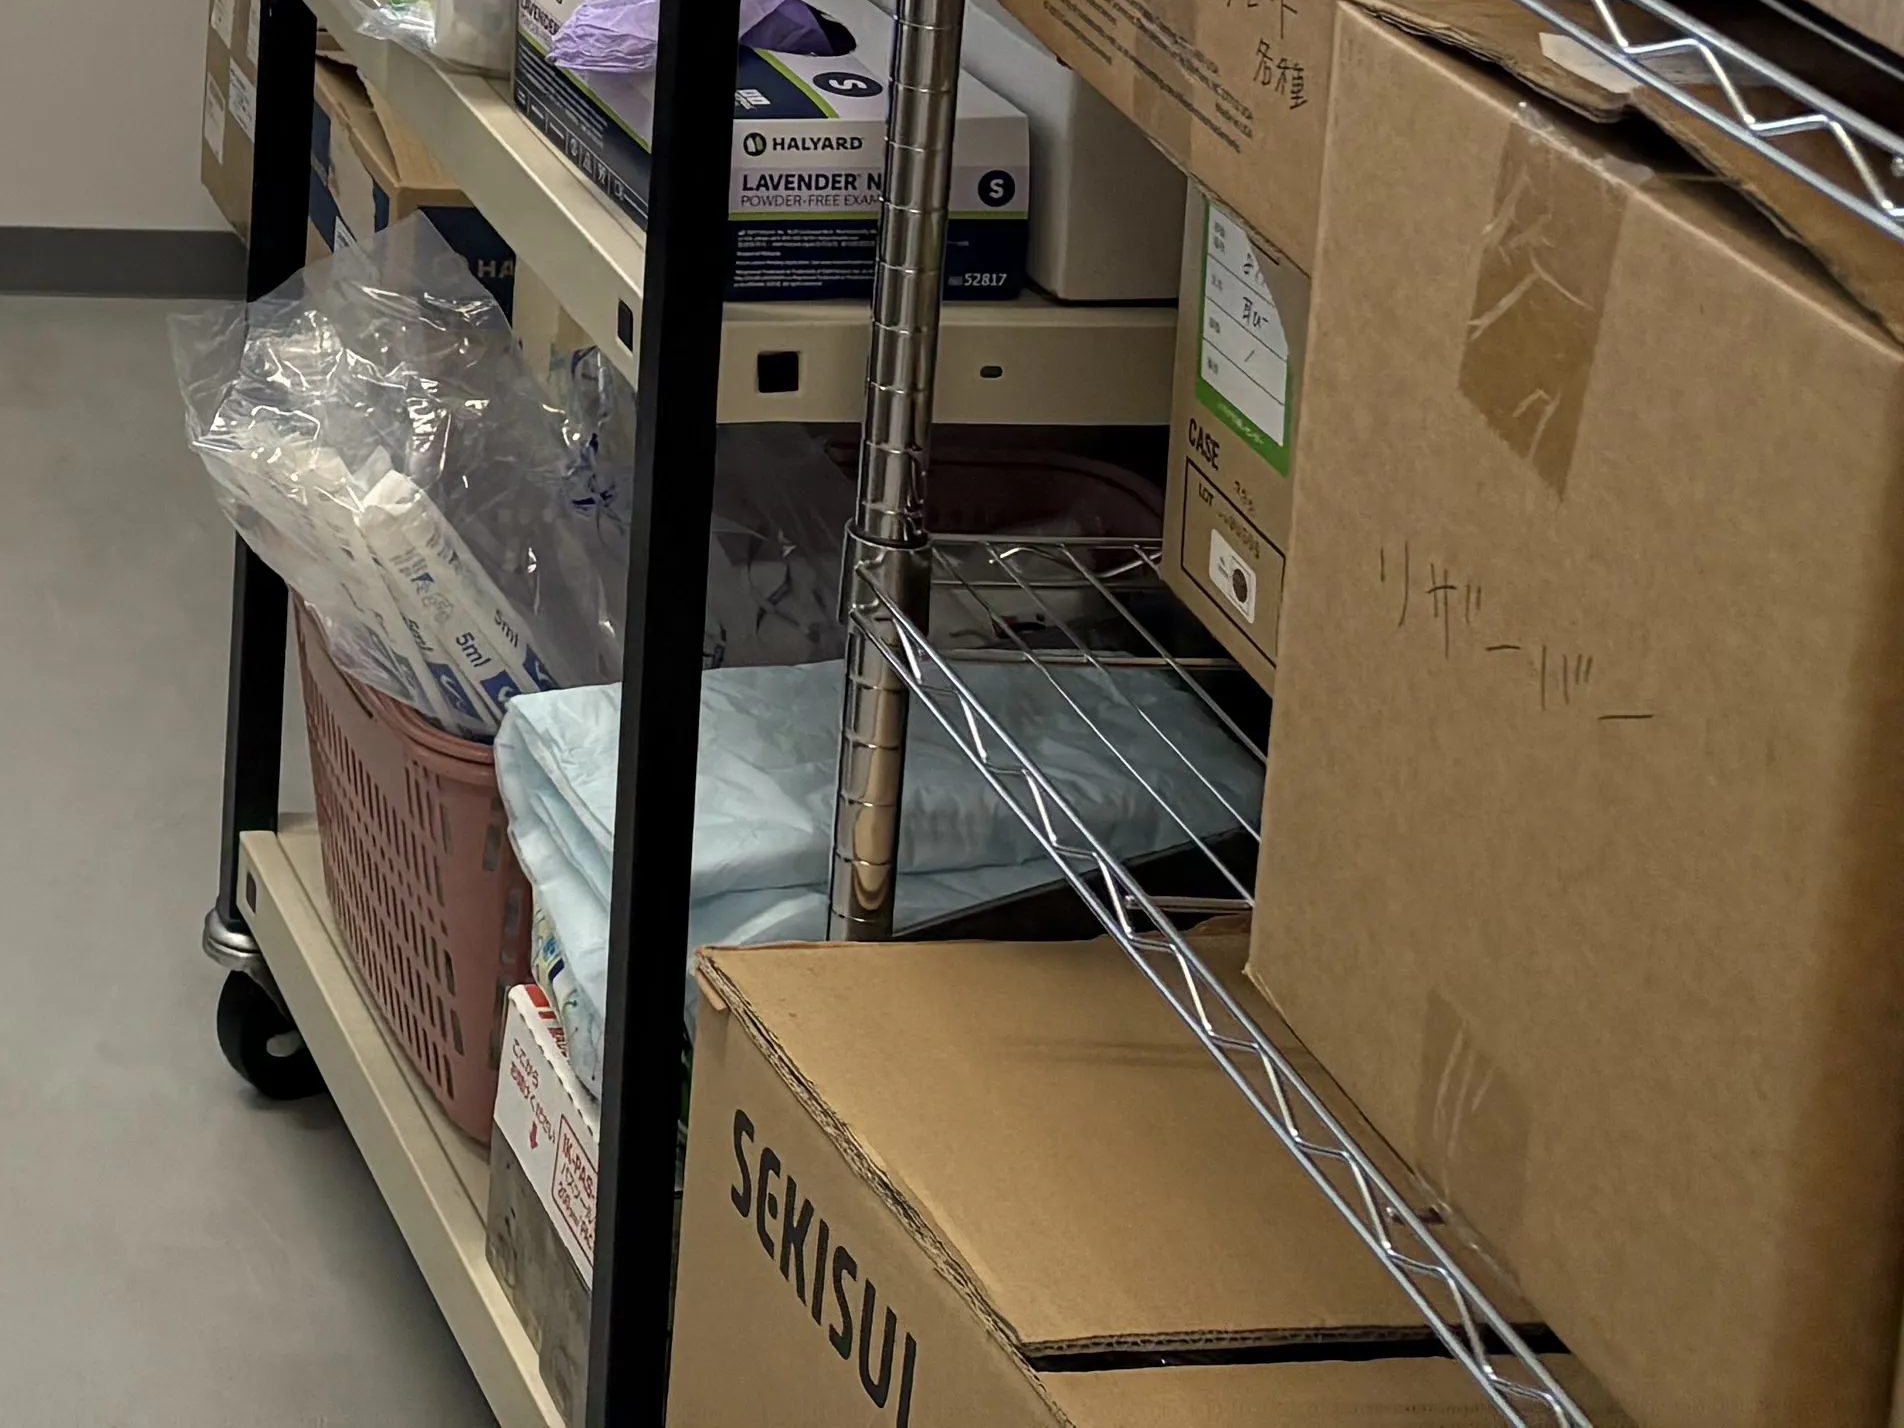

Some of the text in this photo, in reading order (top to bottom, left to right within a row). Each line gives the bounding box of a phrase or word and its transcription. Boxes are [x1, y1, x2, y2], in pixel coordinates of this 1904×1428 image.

[772, 136, 864, 152] HALYARD
[989, 178, 1004, 199] S
[741, 194, 840, 207] POWDER-FREE
[964, 273, 1008, 287] 52817
[1188, 417, 1220, 471] CASE
[1198, 482, 1214, 507] LOT
[455, 632, 492, 669] 5ml
[730, 1108, 917, 1428] SEKISUI
